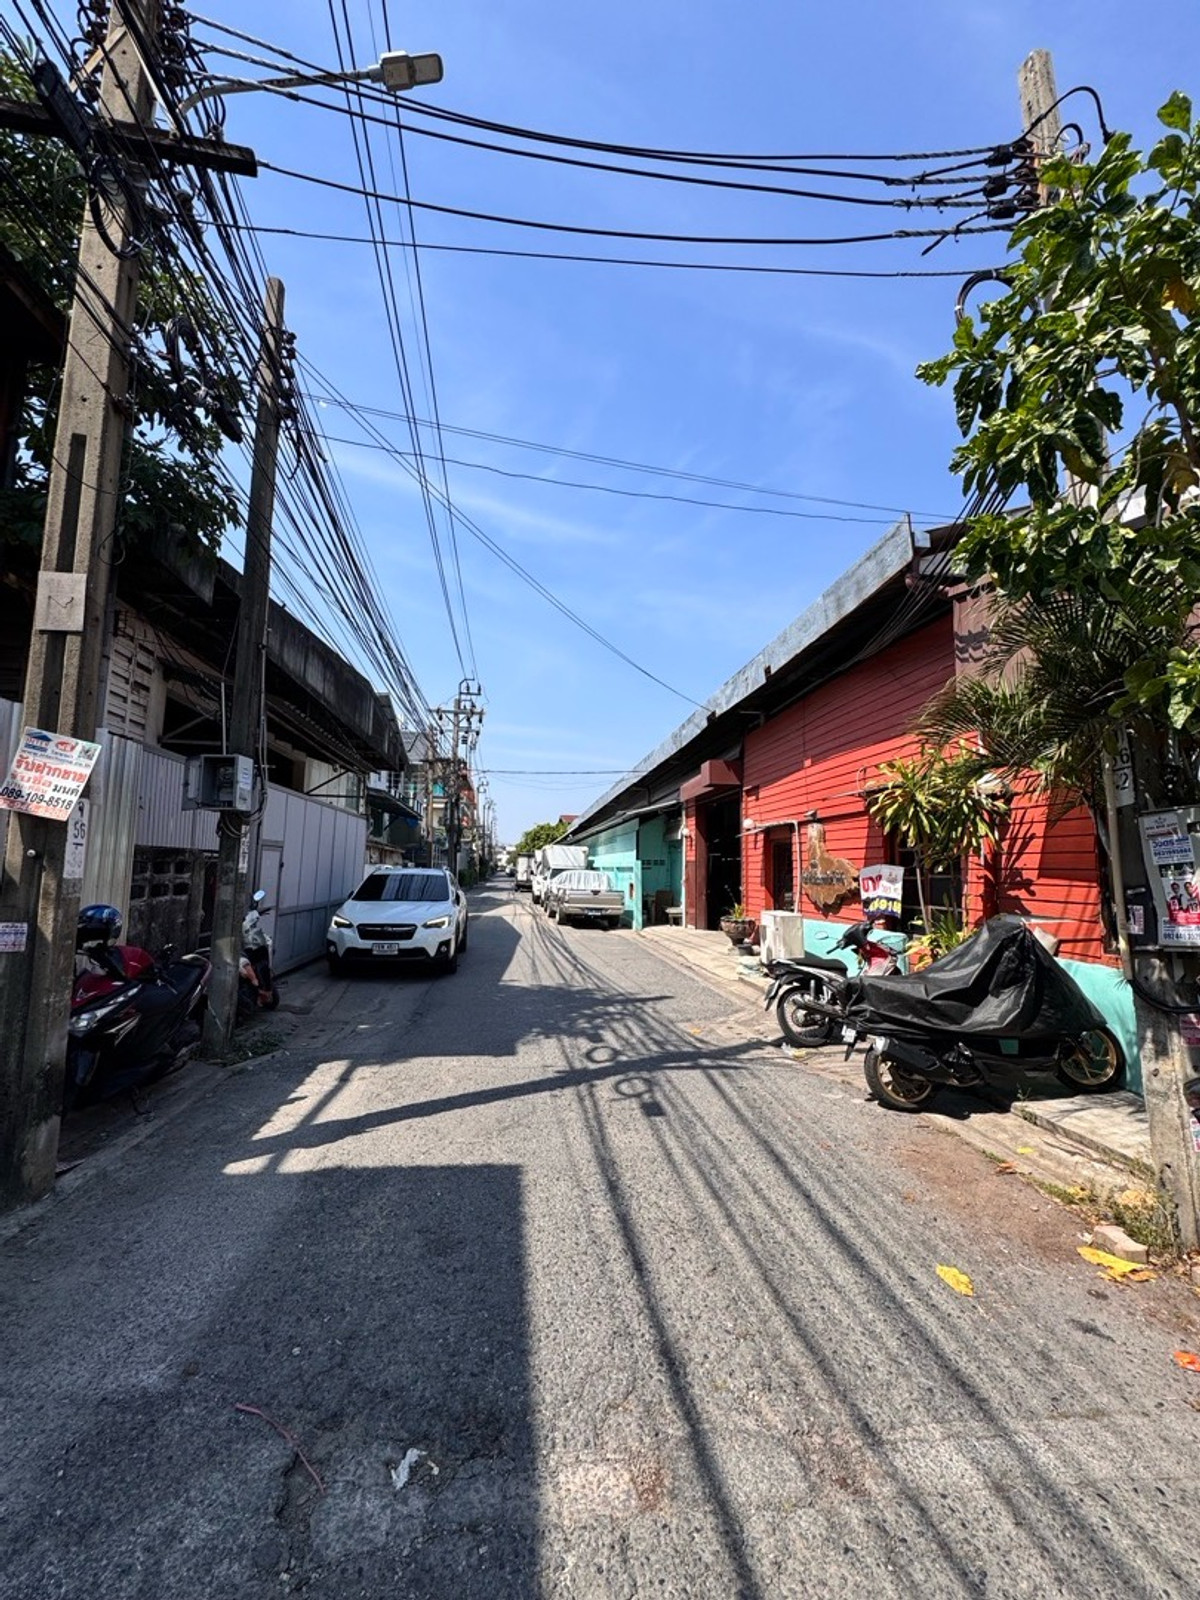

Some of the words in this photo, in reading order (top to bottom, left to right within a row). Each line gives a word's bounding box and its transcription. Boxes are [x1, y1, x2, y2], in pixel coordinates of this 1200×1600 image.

[15, 753, 89, 784] รับฝากขาย
[0, 786, 74, 810] 089-109-8518
[73, 822, 86, 840] 56
